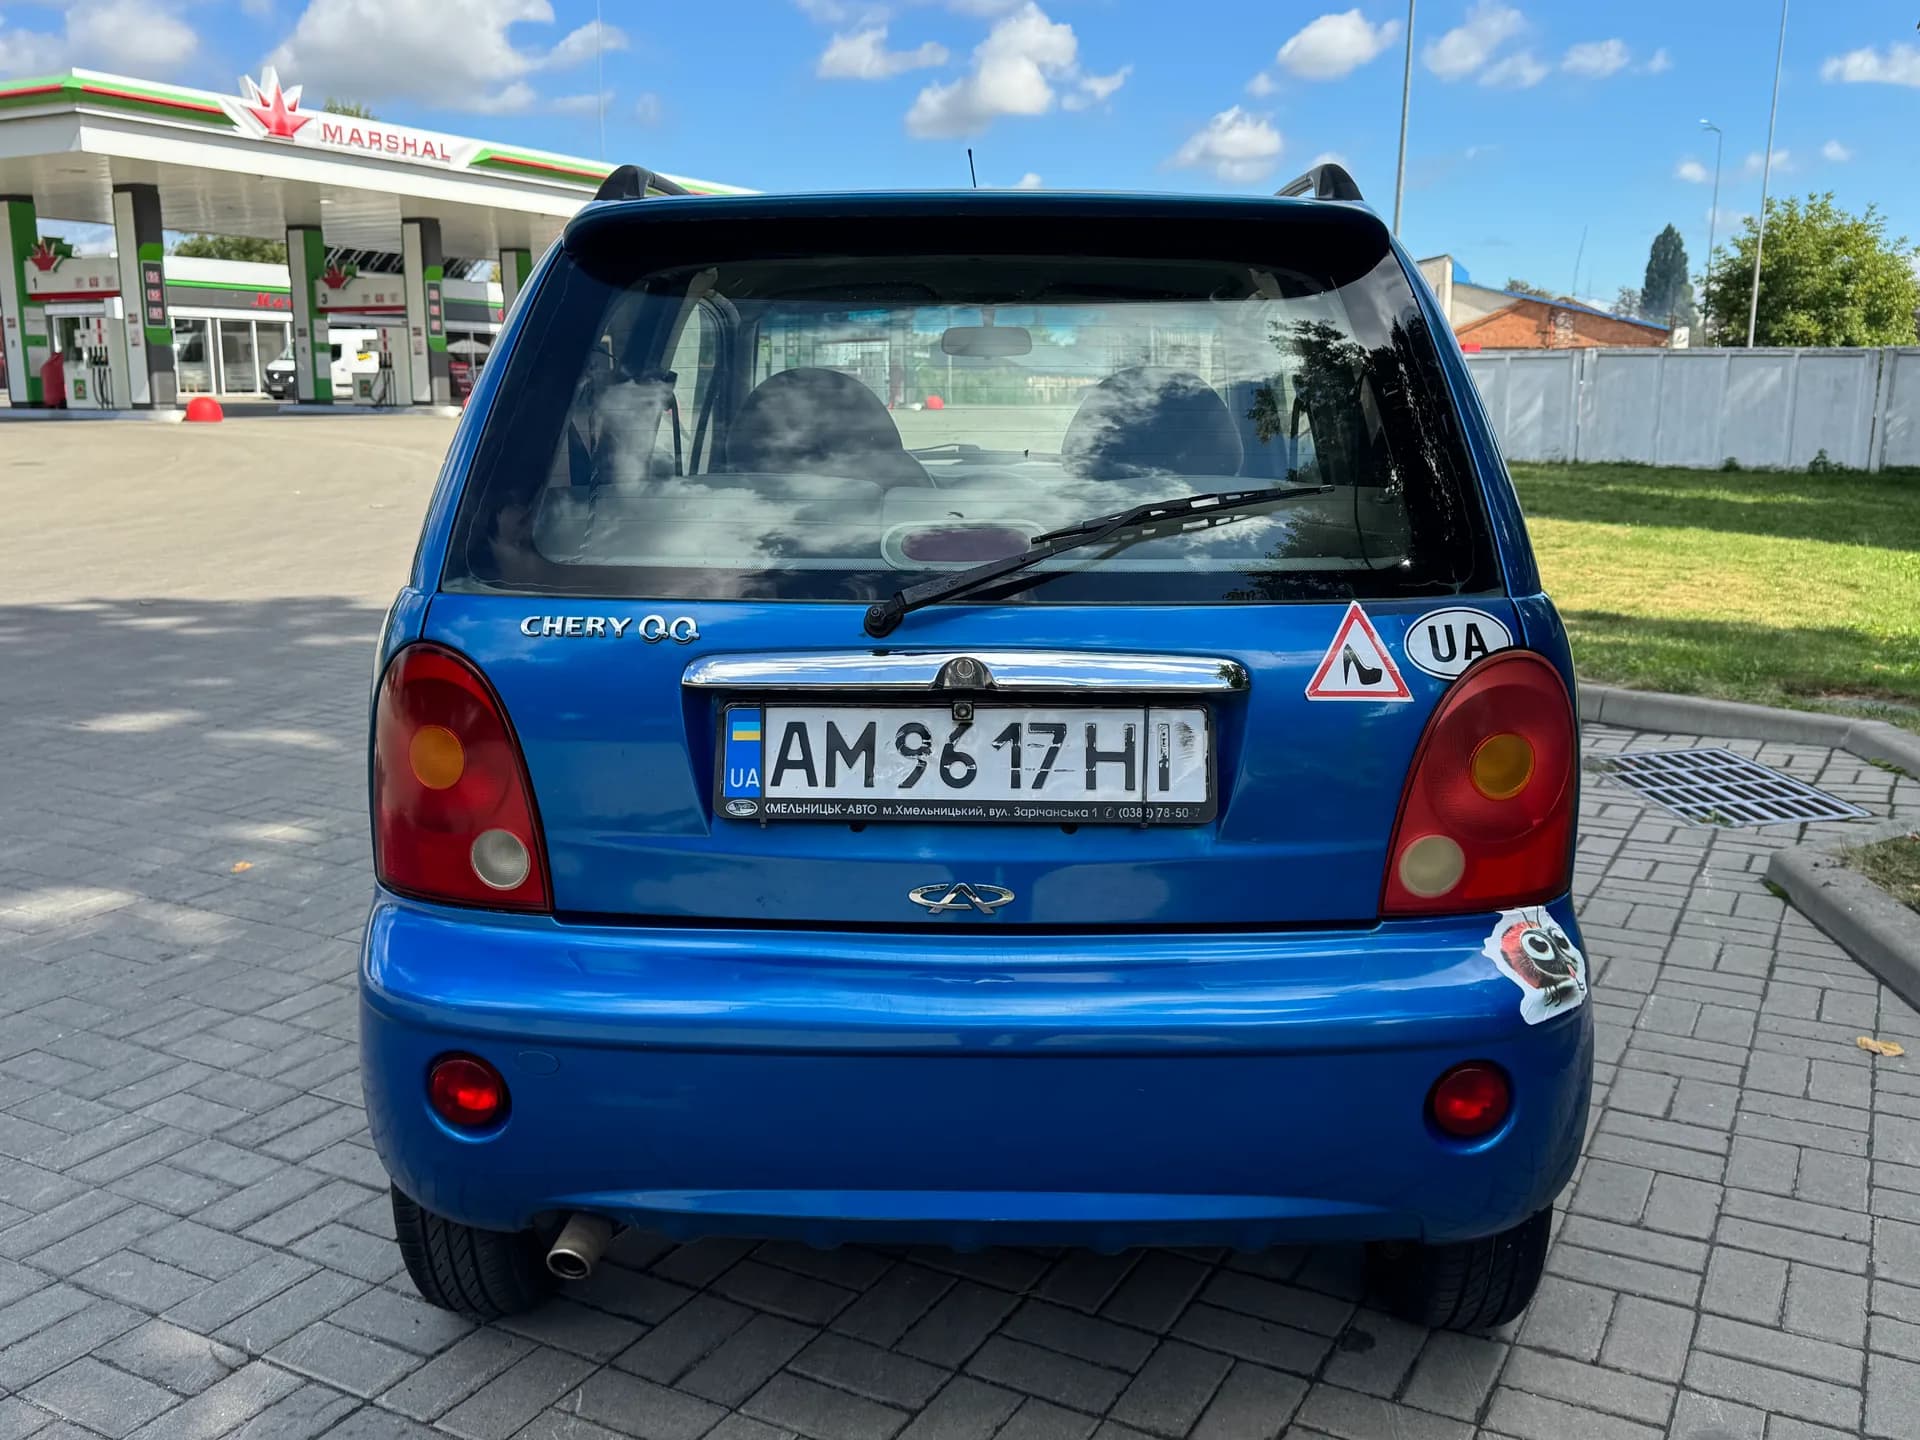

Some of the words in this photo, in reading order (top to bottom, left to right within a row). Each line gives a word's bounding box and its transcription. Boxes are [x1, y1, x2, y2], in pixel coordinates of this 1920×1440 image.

[321, 122, 451, 160] MARSHAL
[520, 616, 632, 637] CHERY
[638, 614, 699, 644] QQ
[1428, 623, 1489, 663] UA
[730, 767, 760, 788] UA
[989, 806, 1010, 819] вул.
[1013, 806, 1089, 820] Зарічанська
